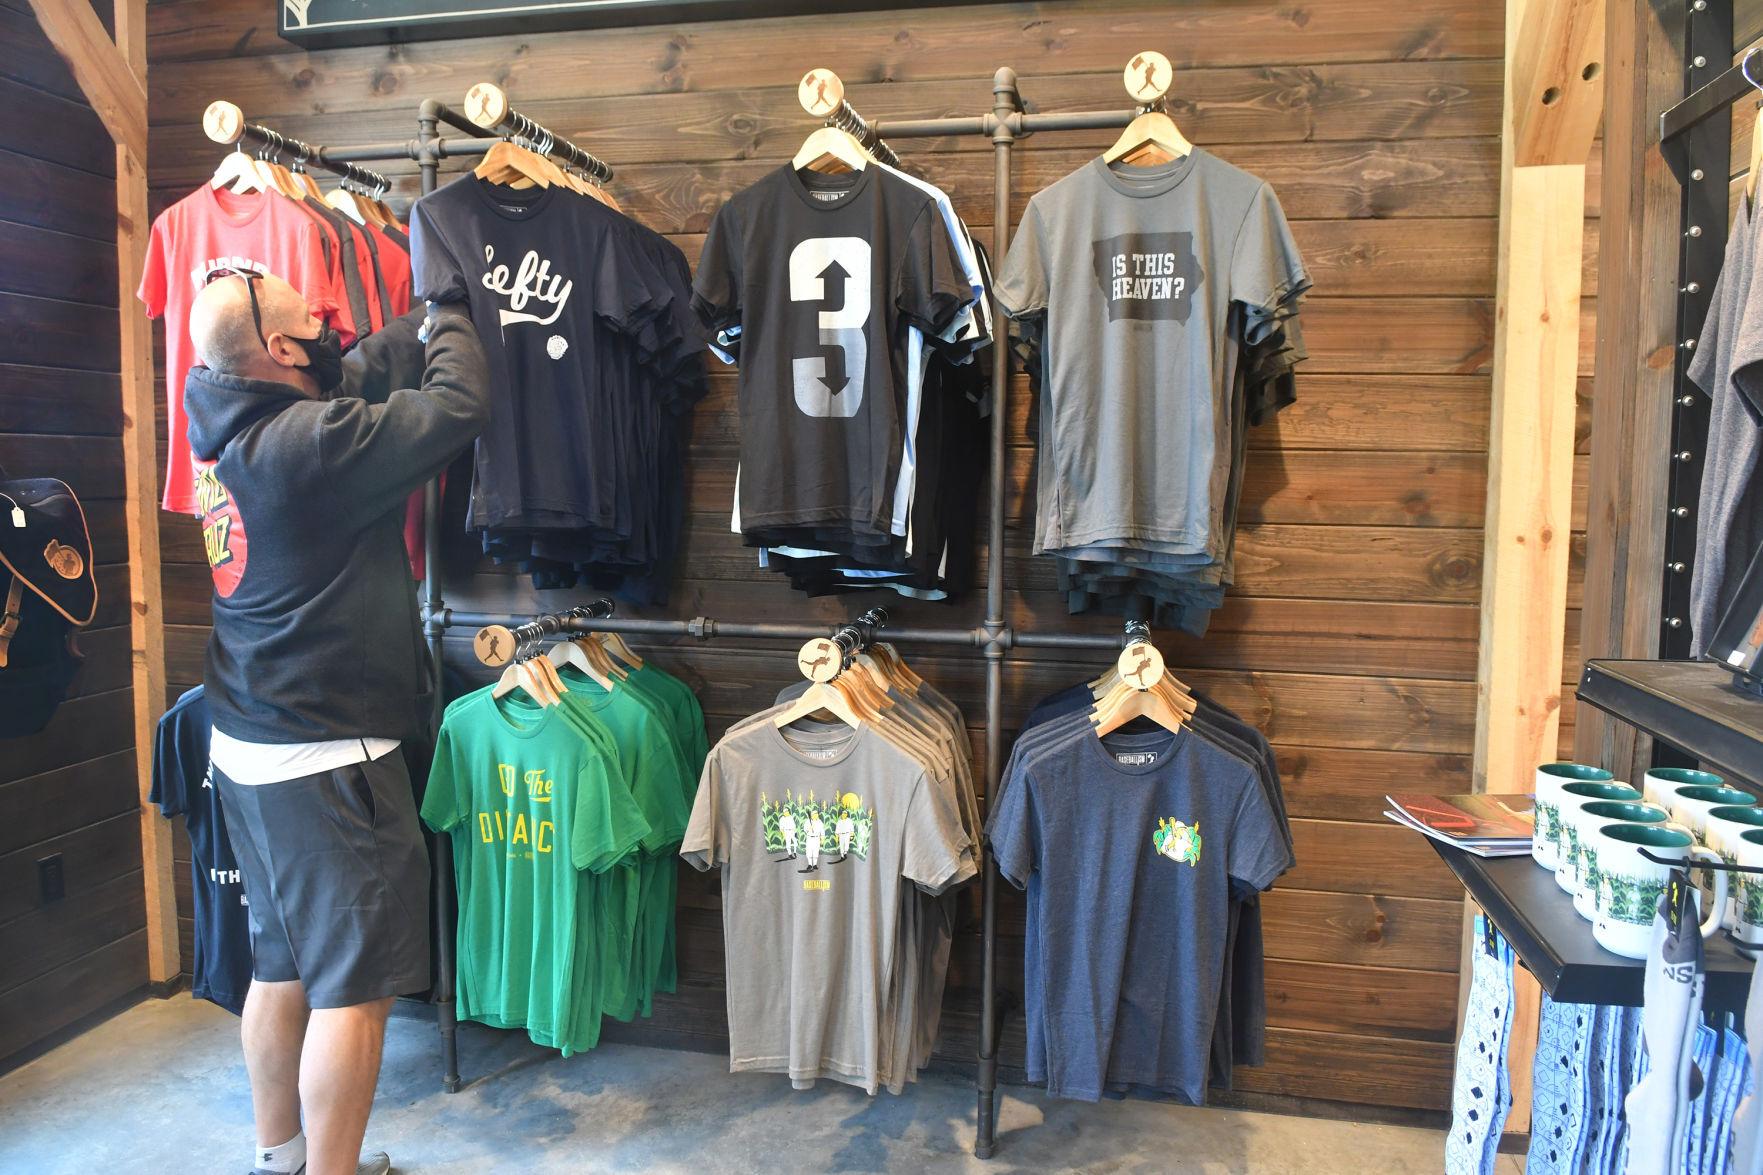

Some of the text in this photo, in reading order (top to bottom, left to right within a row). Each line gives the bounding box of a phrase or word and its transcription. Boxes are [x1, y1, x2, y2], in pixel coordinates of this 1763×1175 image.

[1112, 253, 1175, 278] IS THIS
[1112, 277, 1185, 301] HEAVEN?
[524, 768, 554, 802] The
